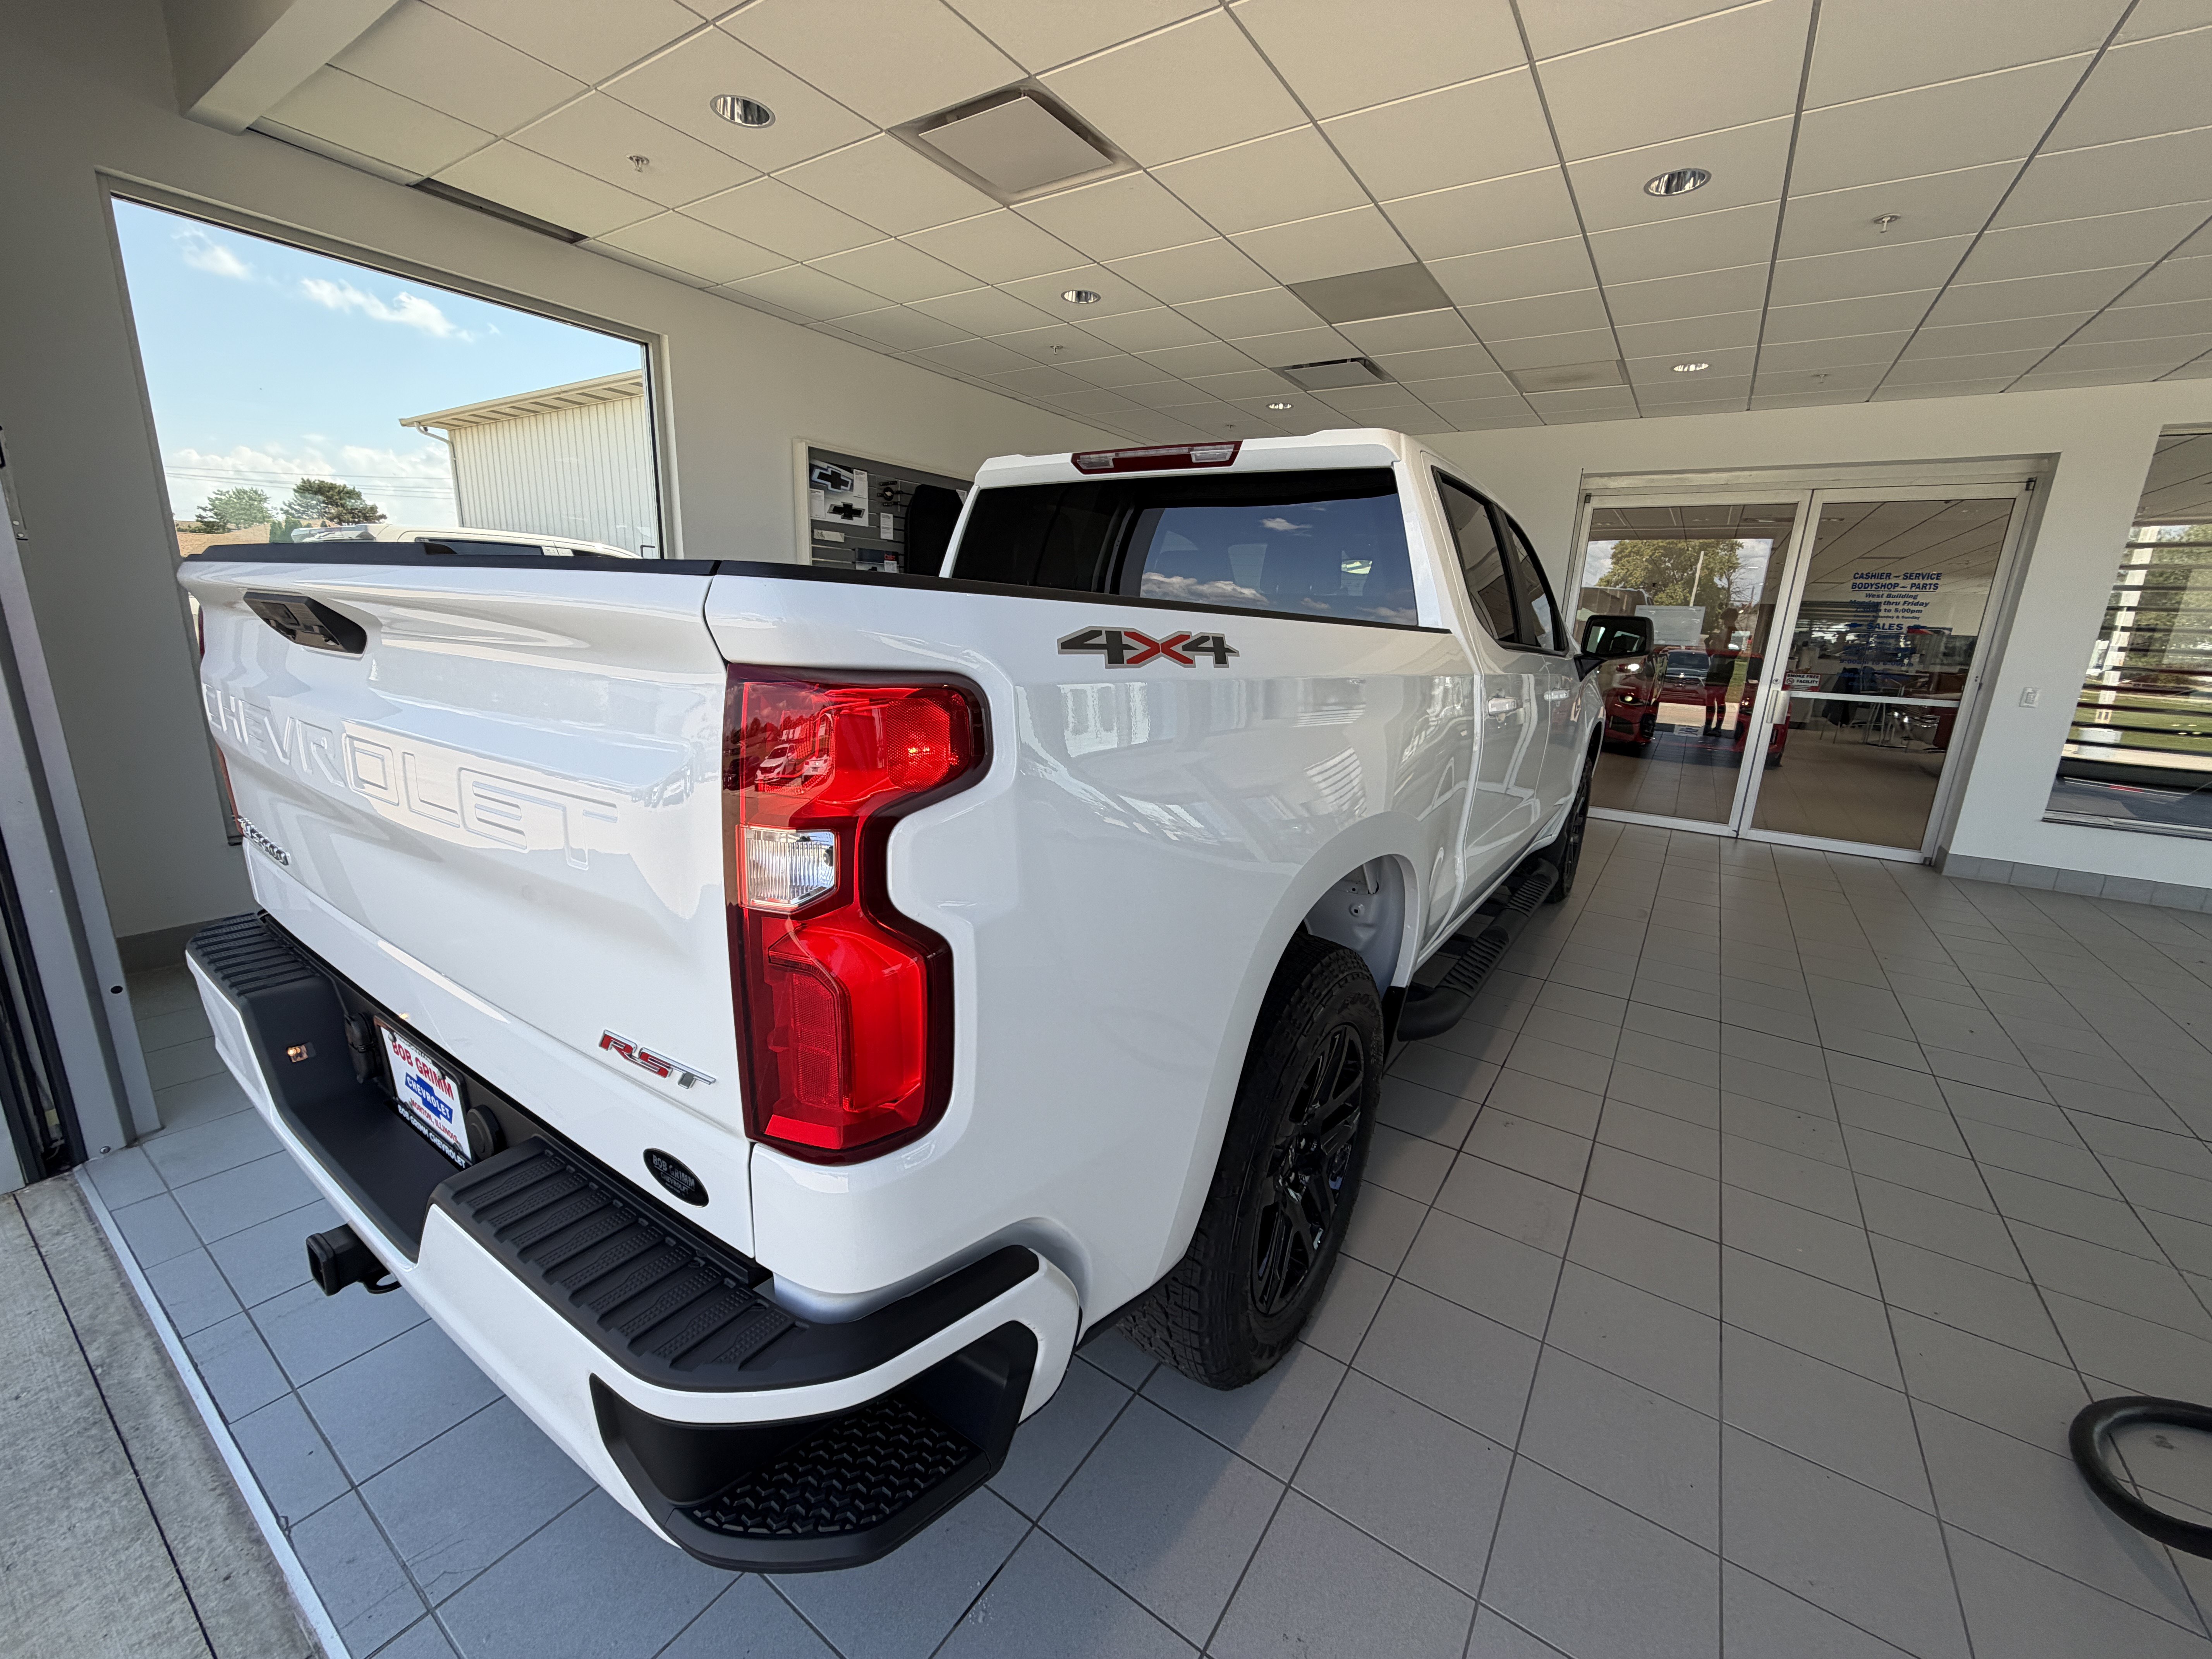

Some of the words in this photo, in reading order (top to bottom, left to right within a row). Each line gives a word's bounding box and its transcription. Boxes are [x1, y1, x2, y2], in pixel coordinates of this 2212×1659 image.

[1867, 622, 1904, 631] SALES
[392, 1041, 414, 1067] BOB
[415, 1057, 454, 1101] GRIMM
[599, 1029, 716, 1089] RST
[407, 1076, 450, 1119] CHEVROLET
[398, 1104, 410, 1121] BOB
[410, 1116, 429, 1138] GRIMM
[429, 1132, 466, 1169] CHEVROLET
[434, 1118, 459, 1144] ILLINOIS
[653, 1154, 668, 1171] BOB
[669, 1165, 695, 1190] GRIMM
[660, 1172, 689, 1195] CHEVROLET
